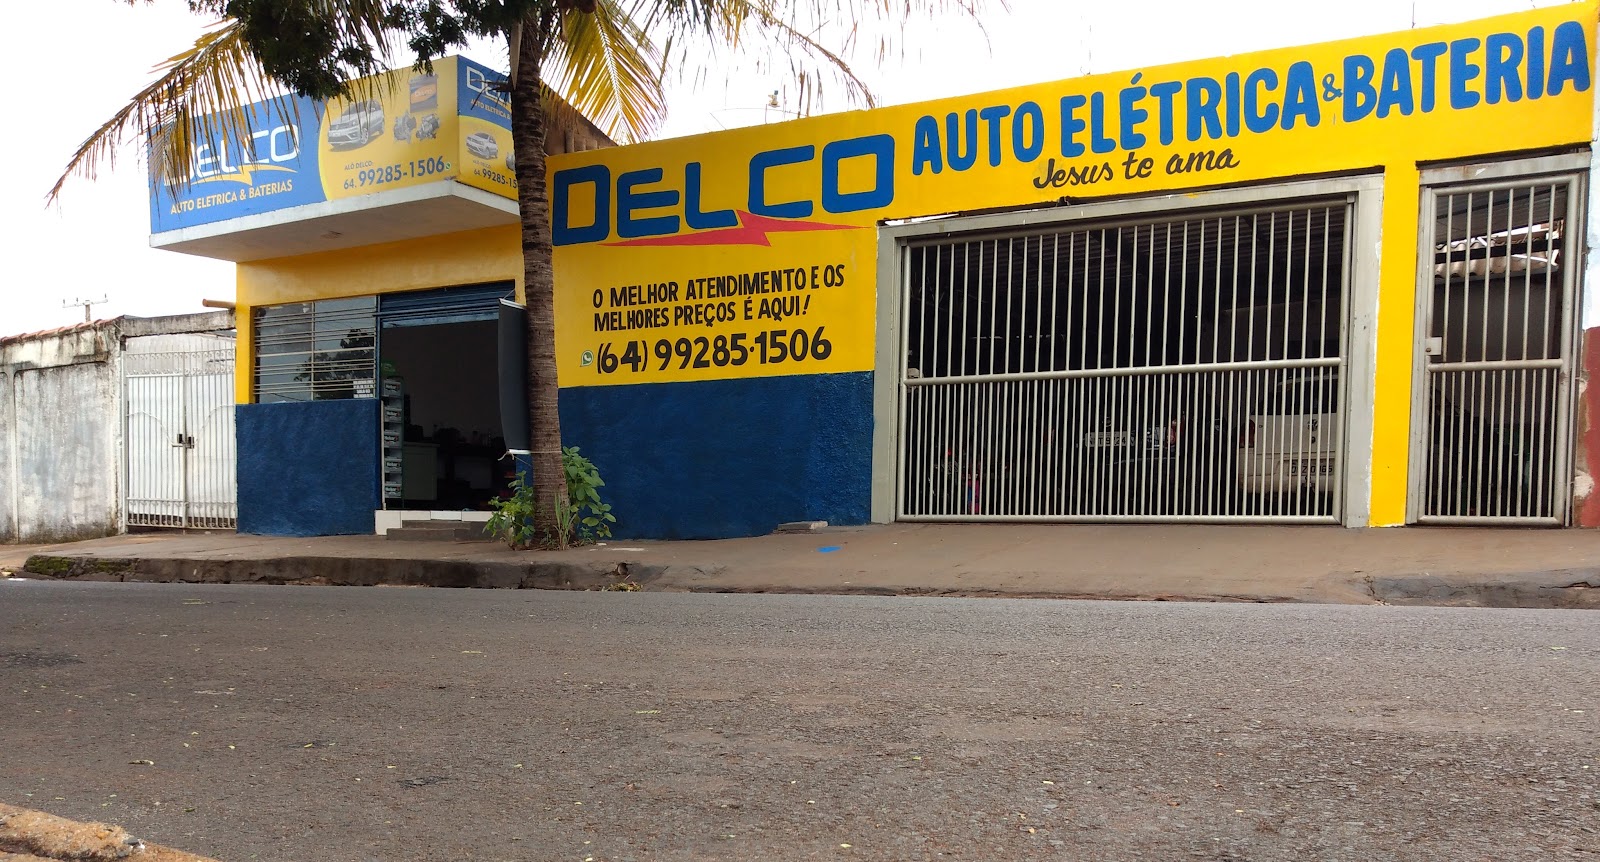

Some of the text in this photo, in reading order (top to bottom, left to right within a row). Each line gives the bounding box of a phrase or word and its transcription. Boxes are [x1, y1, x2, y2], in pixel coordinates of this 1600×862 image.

[912, 21, 1591, 176] AUTO ELÉTRICA & BATERIA
[358, 155, 445, 187] 99285-1506
[1033, 148, 1240, 189] Jesus te ama
[196, 191, 238, 209] ELETRICA
[239, 188, 247, 201] &
[248, 179, 293, 199] BATERIAS
[552, 133, 895, 247] DELCO
[592, 264, 845, 308] O MELHOR ATENDIMENTO E OS
[594, 294, 811, 332] MELHORES PREÇOS É AQUI!
[597, 340, 648, 374] (64)
